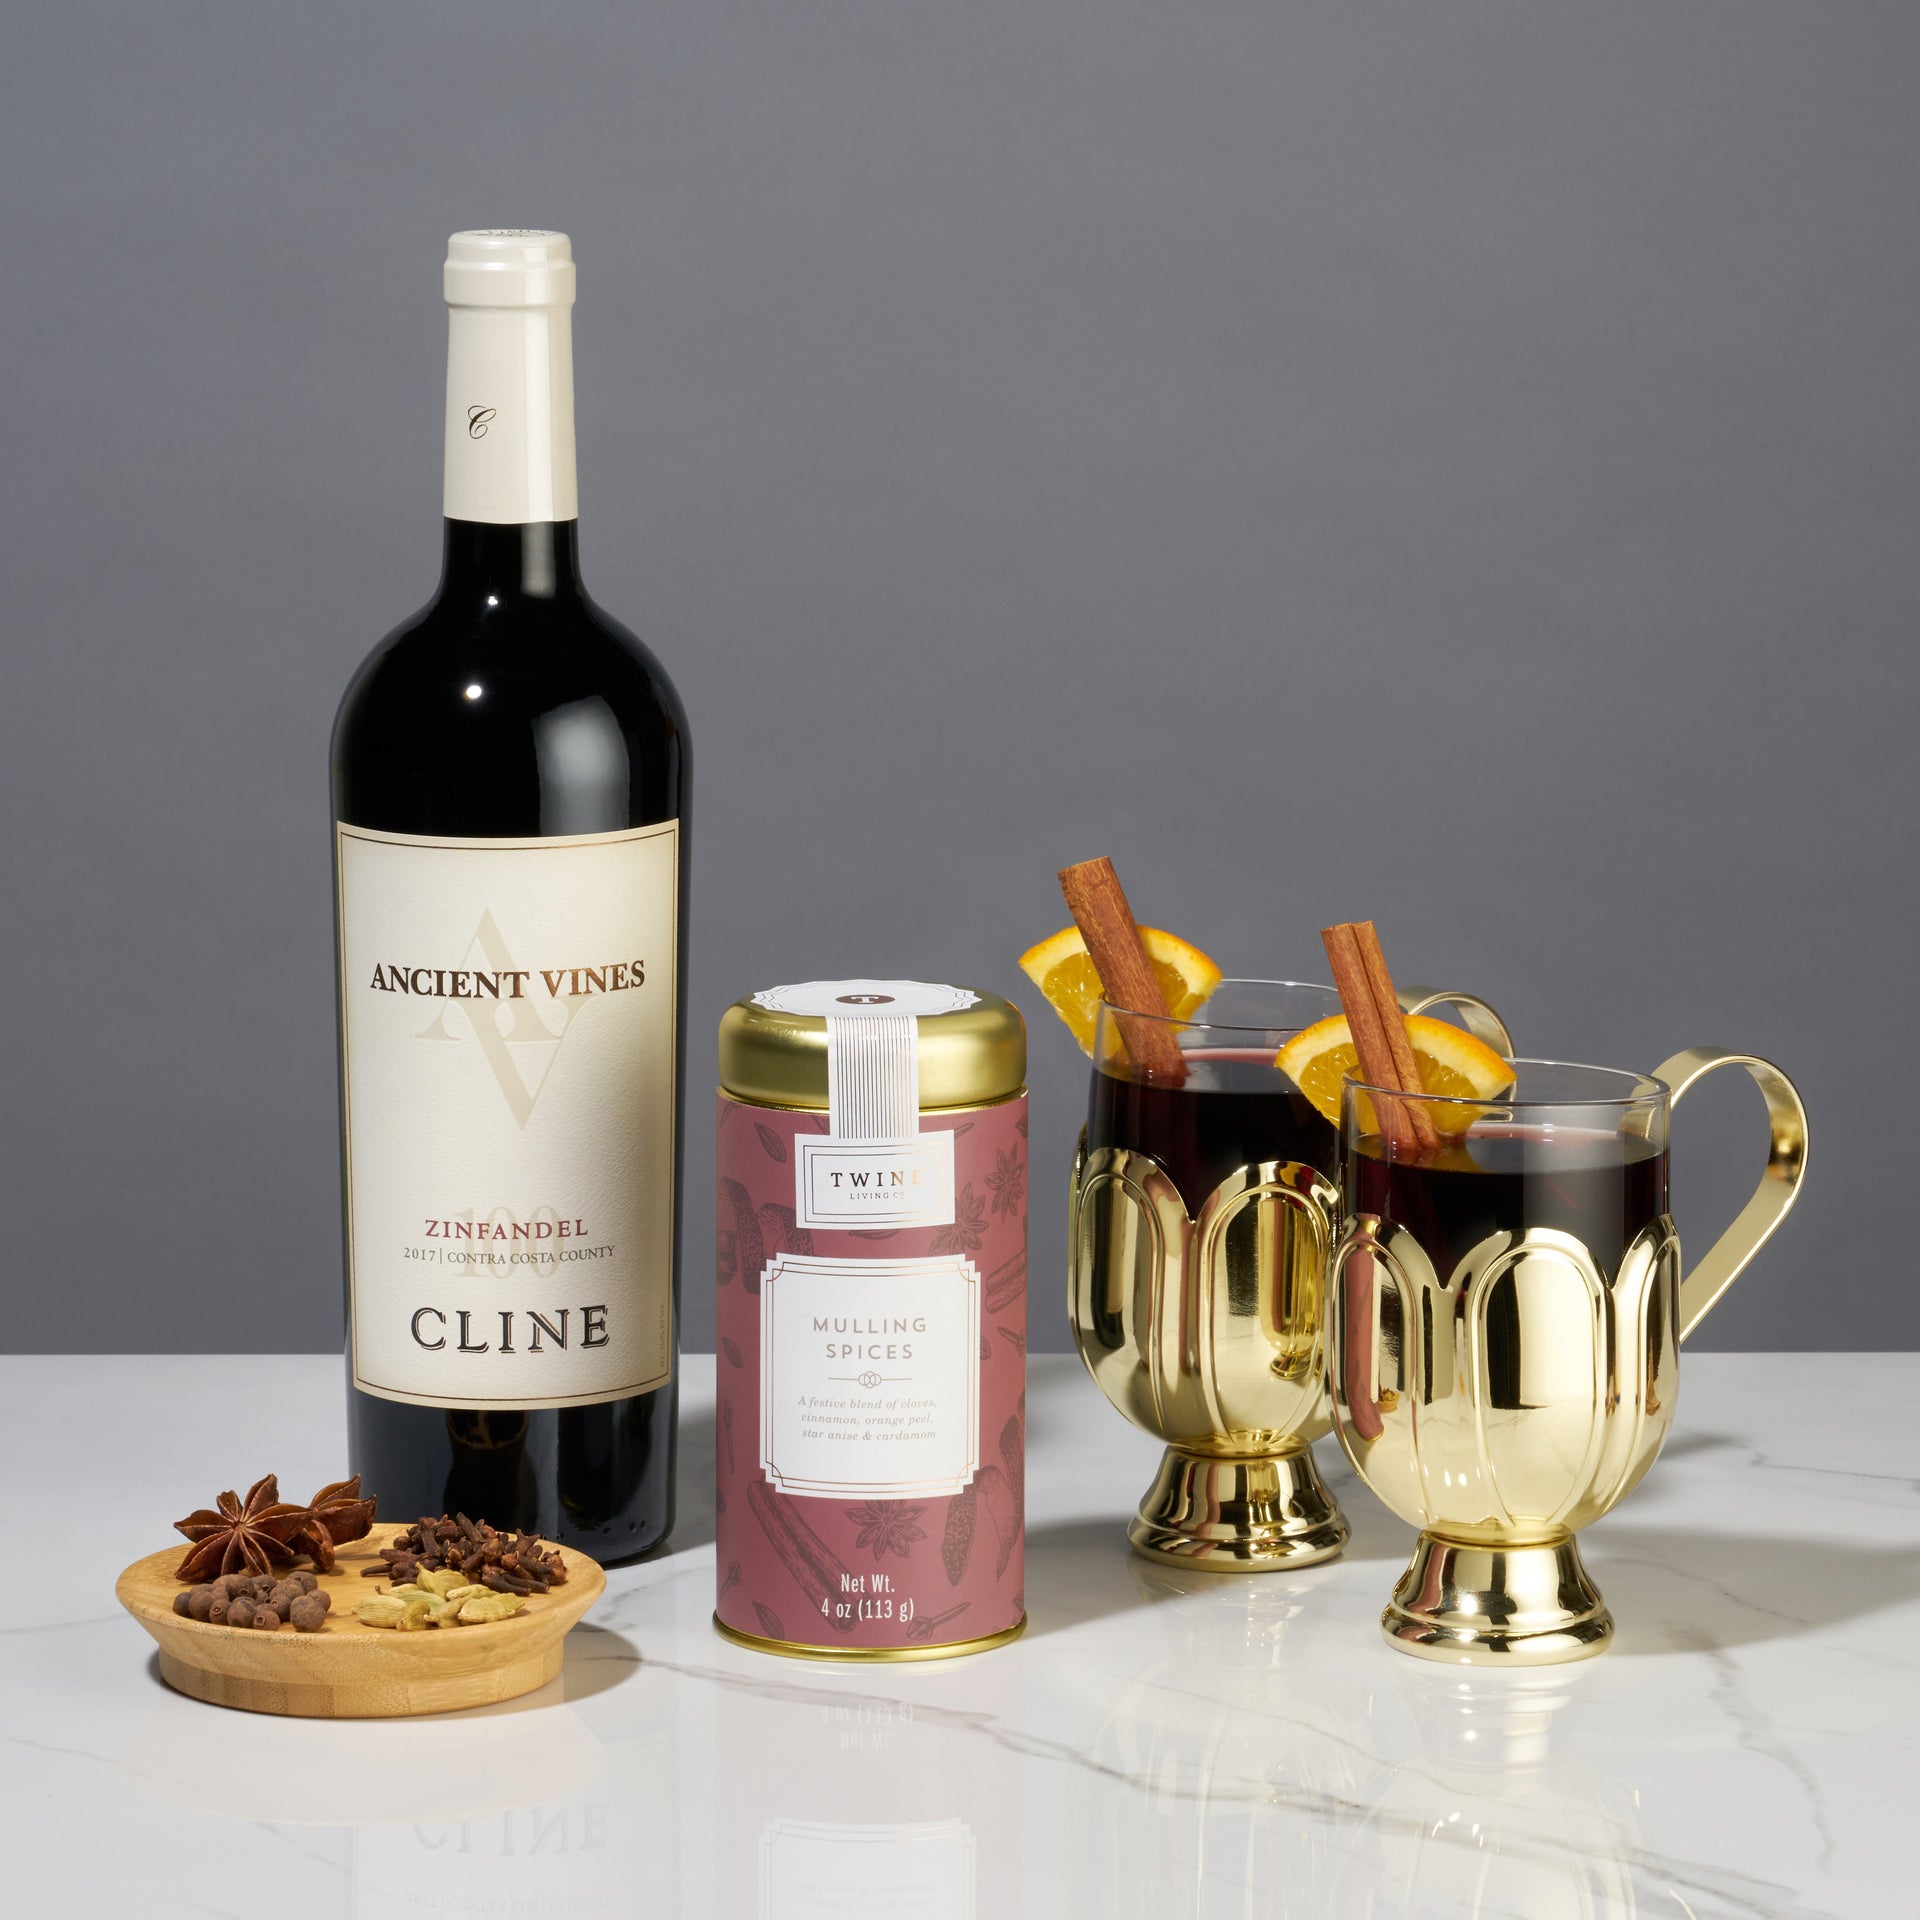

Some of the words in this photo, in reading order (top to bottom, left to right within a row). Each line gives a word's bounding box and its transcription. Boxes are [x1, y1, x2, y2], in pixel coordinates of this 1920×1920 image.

[370, 962, 529, 998] ANCIENT
[539, 959, 645, 997] VINES
[830, 1168, 923, 1187] TWINE
[850, 1192, 889, 1200] LIVING
[425, 1218, 588, 1241] ZINFANDEL
[404, 1247, 436, 1262] 2017
[447, 1250, 506, 1265] CONTRA
[510, 1251, 555, 1265] COSTA
[559, 1245, 616, 1263] COUNTY
[410, 1304, 610, 1354] CLINE
[813, 1316, 927, 1334] MULLING
[826, 1343, 913, 1360] SPICES
[798, 1396, 806, 1406] A
[809, 1397, 845, 1408] festive
[849, 1399, 882, 1409] blend
[886, 1399, 897, 1411] of
[900, 1398, 937, 1409] cloves,
[801, 1412, 861, 1425] cinnamon,
[865, 1417, 904, 1427] orange
[802, 1429, 824, 1438] star
[828, 1431, 858, 1440] anise
[862, 1431, 872, 1441] &
[876, 1430, 936, 1441] cardamom
[841, 1573, 865, 1593] Net
[871, 1574, 895, 1593] Wt.
[821, 1598, 830, 1617] 4
[836, 1603, 851, 1618] oz
[858, 1599, 893, 1622] (113
[899, 1598, 914, 1622] g)
